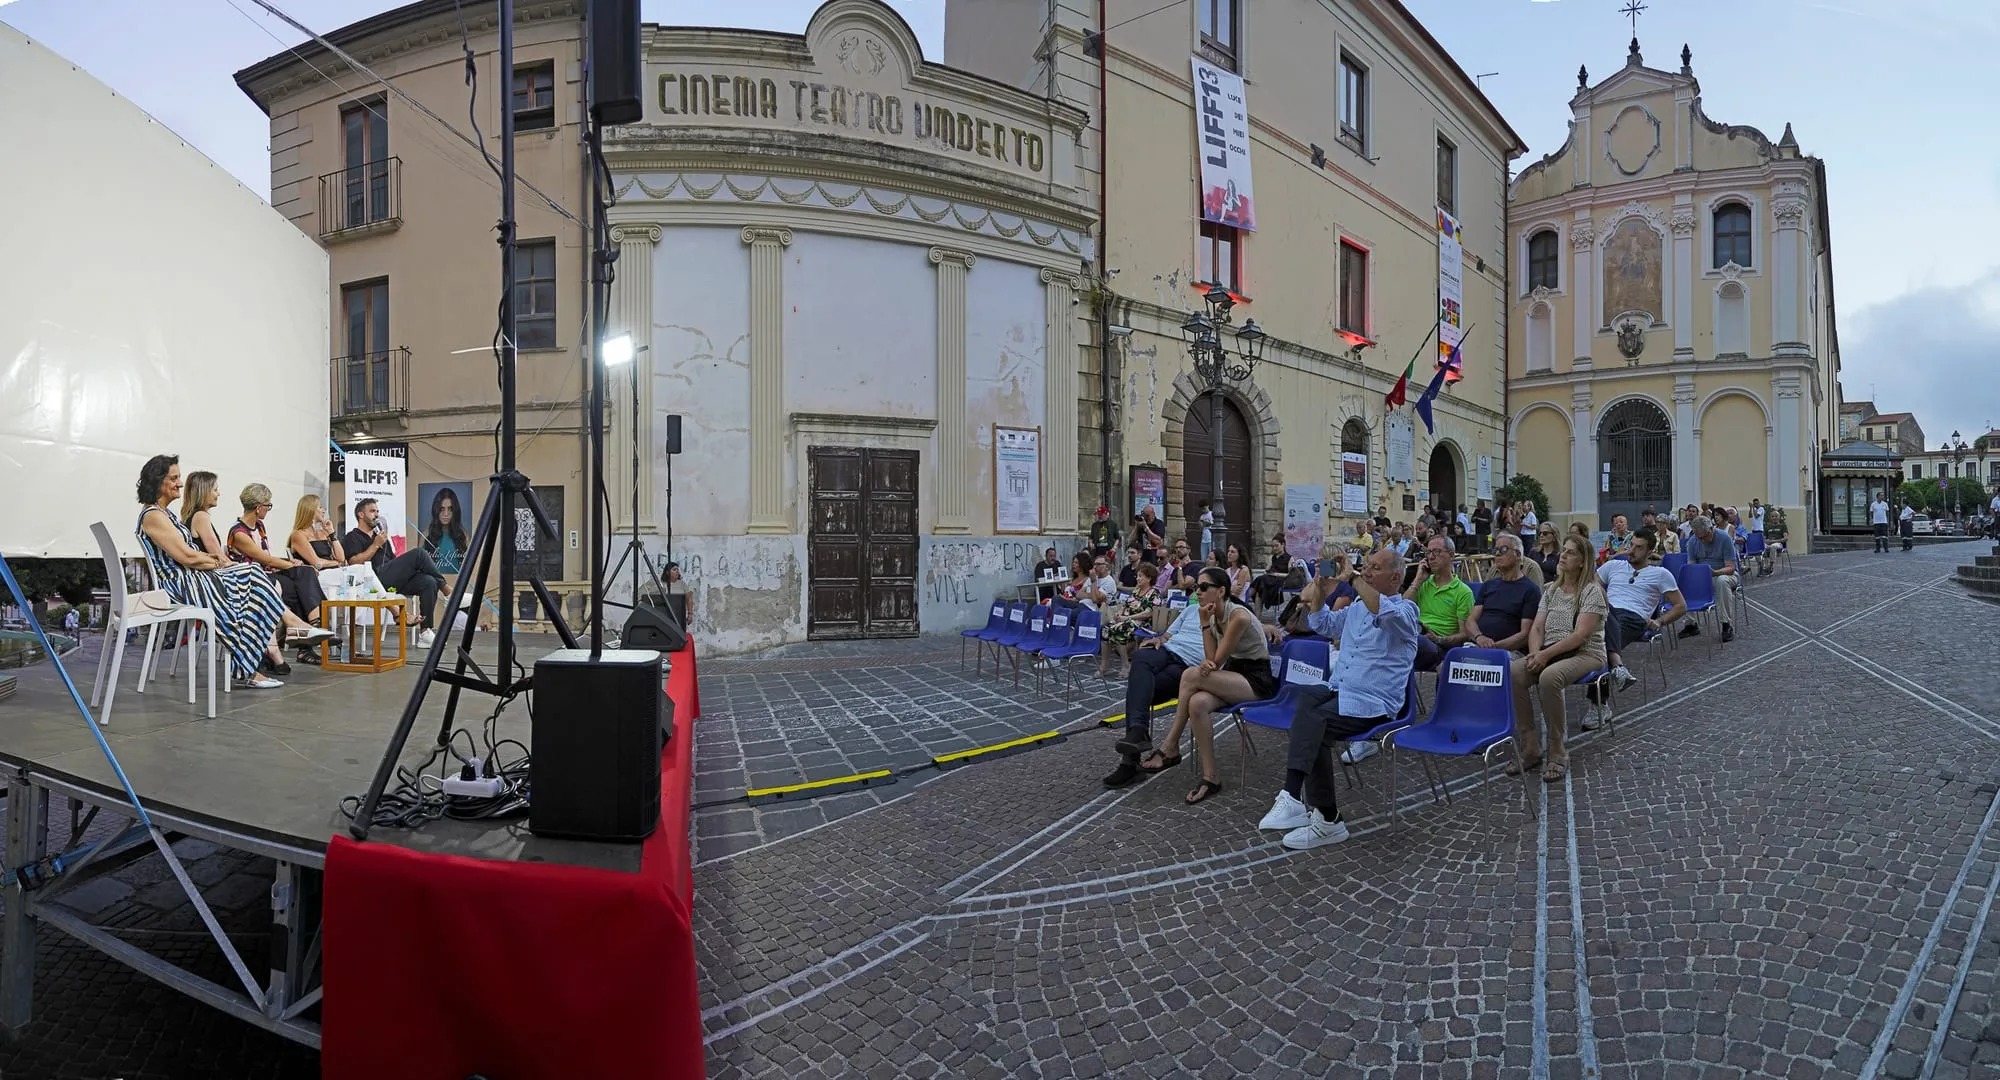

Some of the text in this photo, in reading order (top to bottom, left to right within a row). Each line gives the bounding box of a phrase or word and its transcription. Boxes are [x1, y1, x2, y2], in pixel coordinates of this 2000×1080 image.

[658, 73, 1043, 172] CINEMA TEATRO UMBERTO
[1198, 66, 1228, 169] LIFF13
[353, 468, 398, 485] LIFF13
[1452, 667, 1501, 684] RISERVATO
